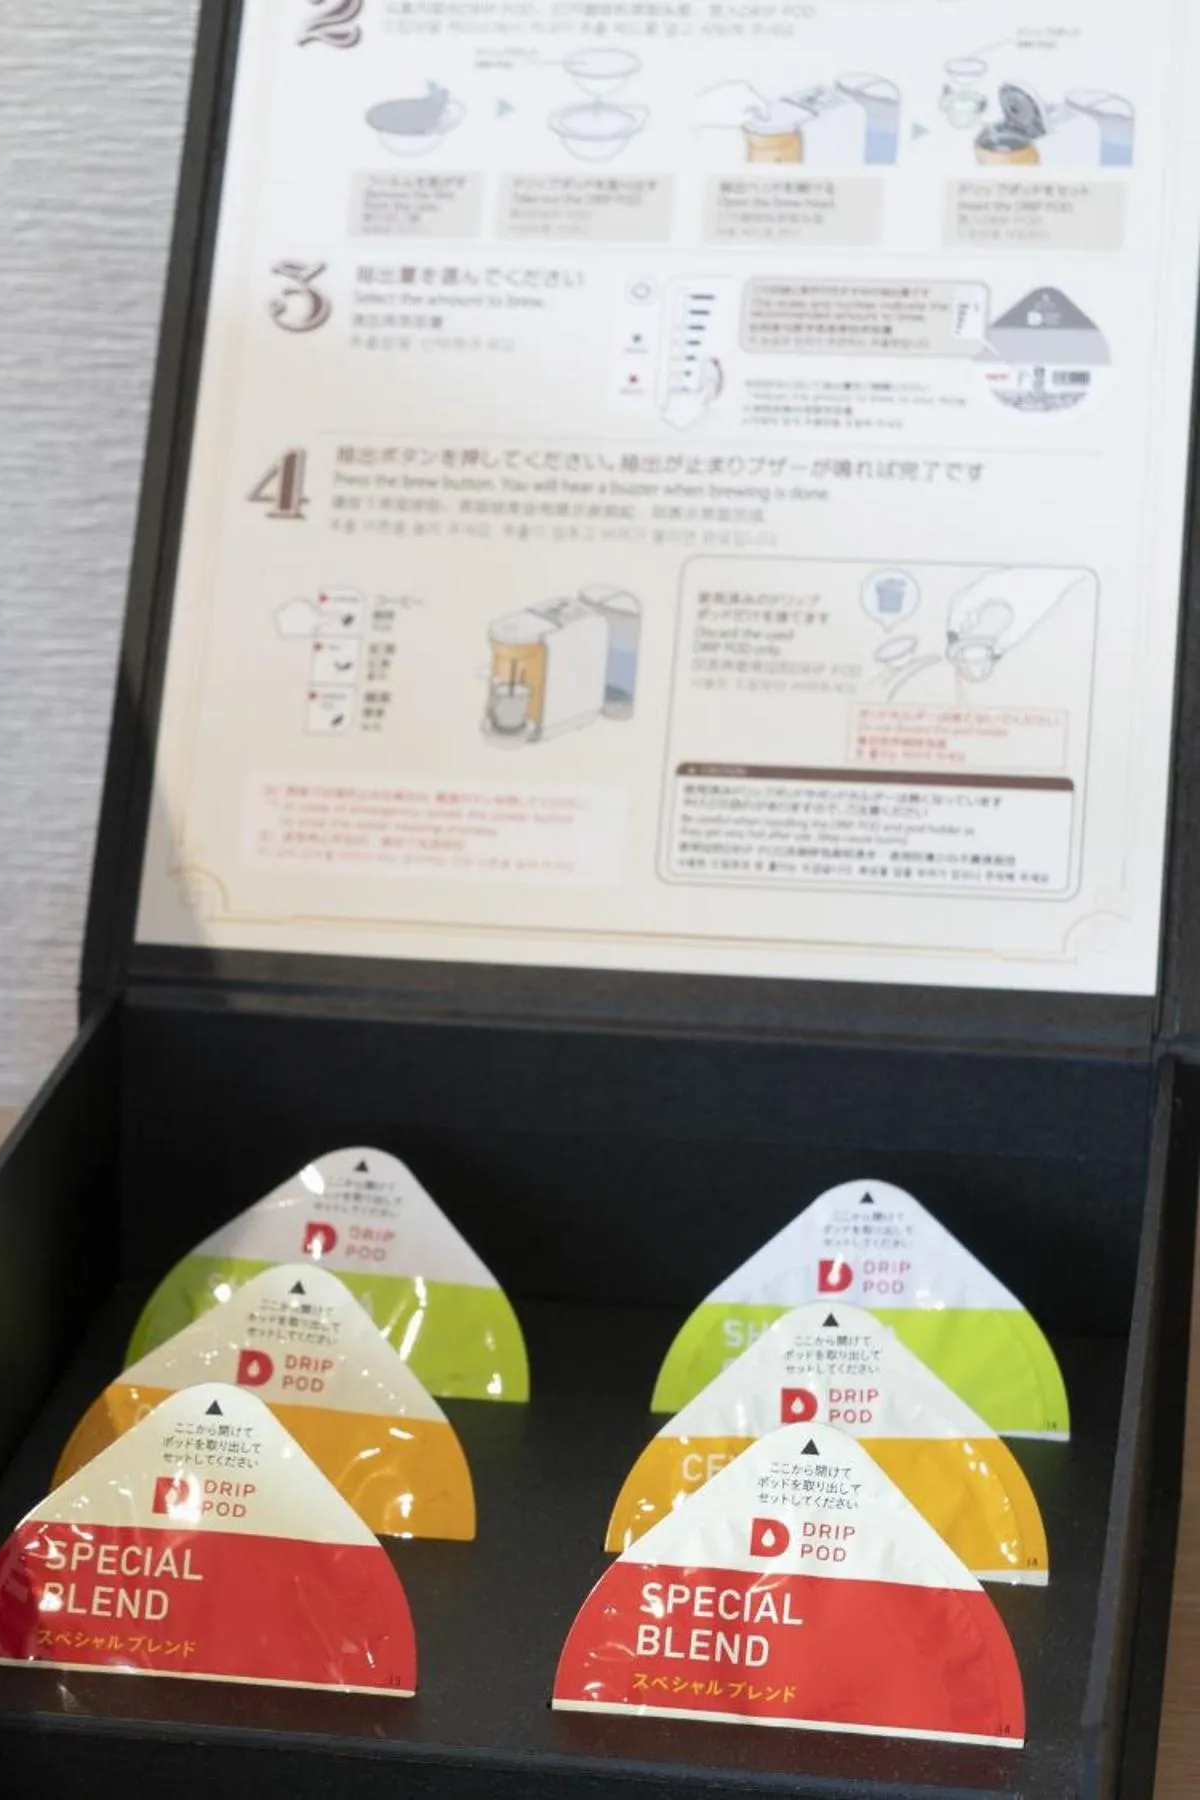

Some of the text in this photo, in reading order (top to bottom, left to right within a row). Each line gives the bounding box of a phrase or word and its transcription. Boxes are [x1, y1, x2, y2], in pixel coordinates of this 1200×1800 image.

[270, 261, 331, 333] 3
[249, 448, 309, 520] 4
[349, 1225, 396, 1242] DRIP
[345, 1243, 387, 1262] POD
[863, 1259, 911, 1276] DRIP
[863, 1278, 904, 1295] POD
[284, 1353, 335, 1374] DRIP
[282, 1374, 326, 1393] POD
[829, 1388, 880, 1404] DRIP
[829, 1408, 873, 1424] POD
[175, 1422, 255, 1438] ここから開けて
[162, 1436, 262, 1455] ポッドを取り出して
[163, 1453, 260, 1469] セットしてください
[770, 1462, 853, 1479] ここから開けて
[204, 1479, 256, 1498] DRIP
[757, 1477, 863, 1496] ポッドを取り出して
[201, 1500, 247, 1518] POD
[758, 1493, 860, 1511] セットしてください
[802, 1521, 856, 1541] DRIP
[45, 1540, 205, 1581] SPECIAL
[800, 1543, 847, 1563] POD
[39, 1581, 170, 1621] BLEND
[639, 1581, 804, 1626] SPECIAL
[635, 1624, 770, 1668] BLEND
